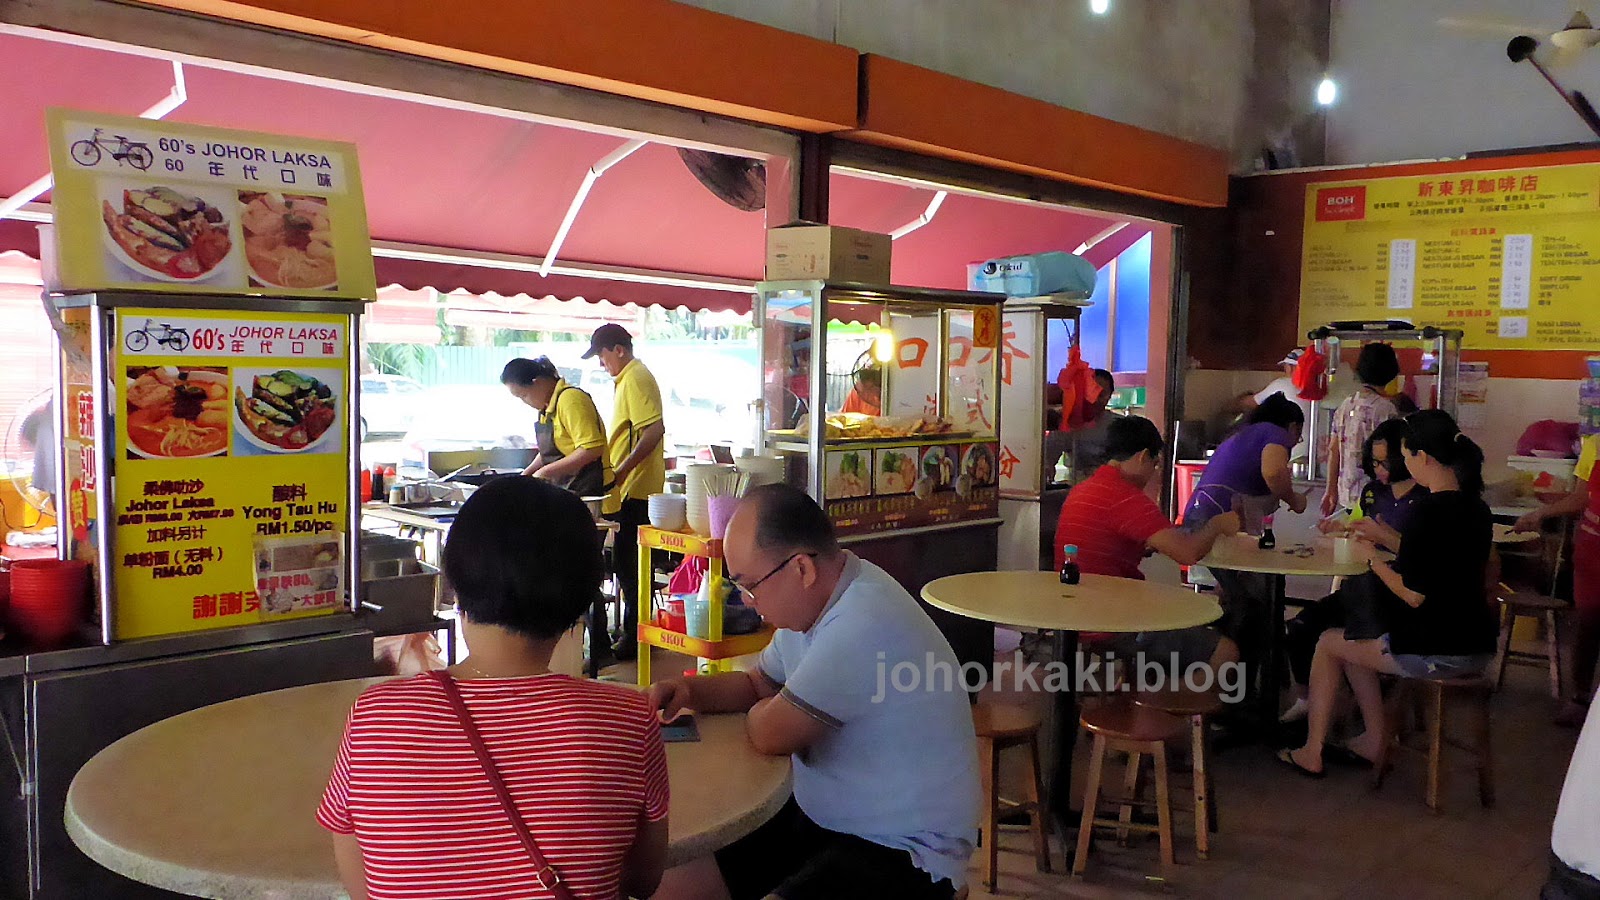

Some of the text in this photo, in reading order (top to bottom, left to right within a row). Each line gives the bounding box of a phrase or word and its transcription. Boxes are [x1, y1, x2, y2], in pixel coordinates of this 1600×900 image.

[159, 137, 332, 169] 60's JOHOR LAKSA
[165, 158, 184, 172] 60
[193, 327, 337, 351] 60's JOHOR LAKSA
[125, 499, 169, 512] Johor
[242, 501, 337, 520] Yong Tau Hu
[147, 525, 207, 543] 加料另计
[256, 519, 334, 535] RM1.50/pc
[660, 534, 687, 549] SKOL
[153, 564, 204, 579] RM4.00
[660, 632, 687, 648] SKOL
